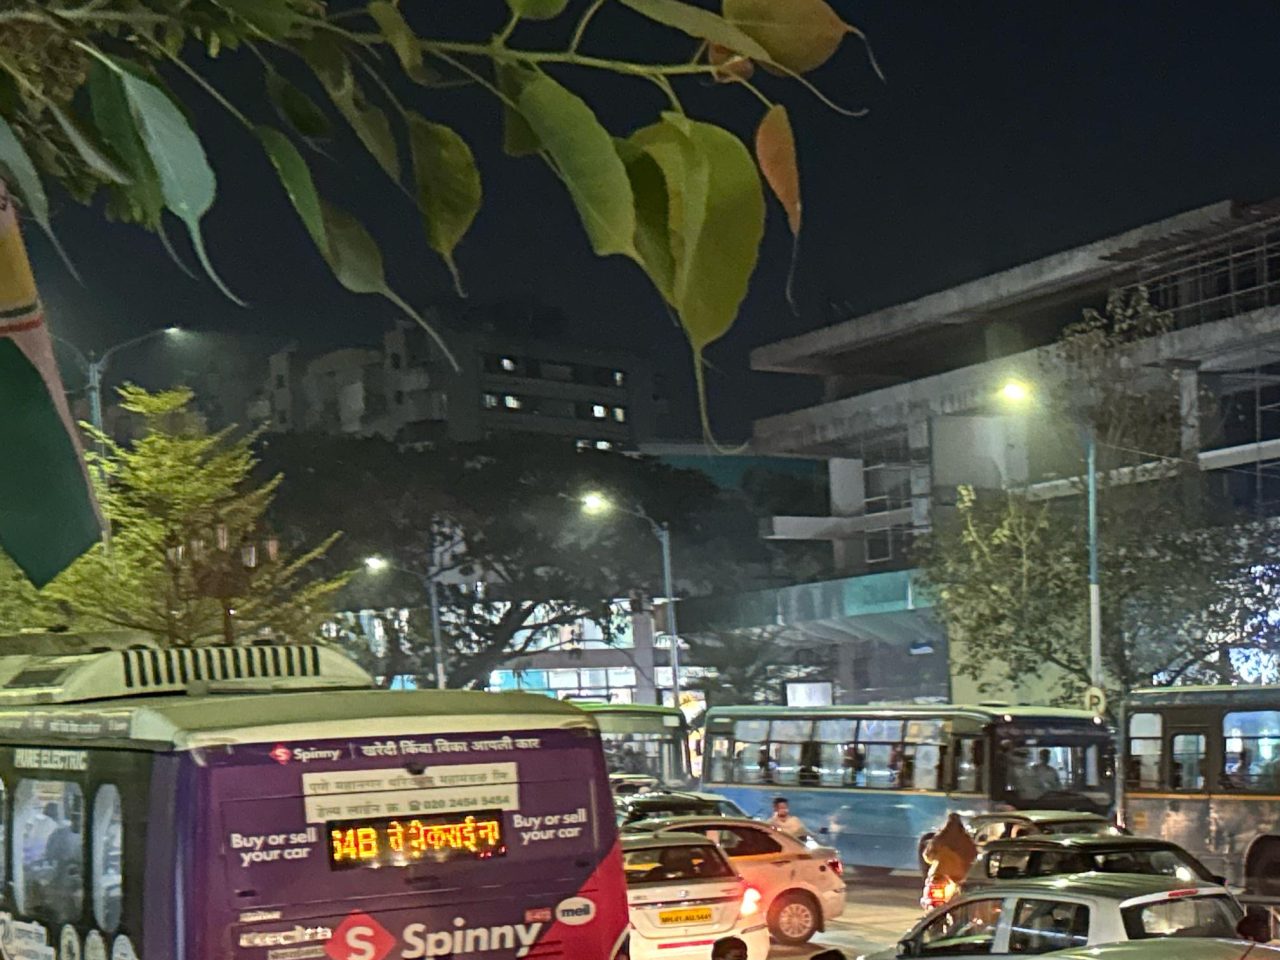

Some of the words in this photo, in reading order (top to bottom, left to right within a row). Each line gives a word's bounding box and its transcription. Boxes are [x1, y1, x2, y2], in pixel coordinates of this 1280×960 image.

[293, 747, 342, 762] Spinny
[514, 738, 541, 749] कार
[513, 814, 542, 831] Buy
[544, 815, 559, 826] or
[561, 809, 587, 824] sell
[231, 834, 266, 853] Buy
[269, 834, 287, 846] or
[288, 827, 318, 845] sell
[520, 829, 560, 845] your
[561, 826, 583, 838] car
[240, 850, 285, 868] your
[287, 846, 311, 860] car
